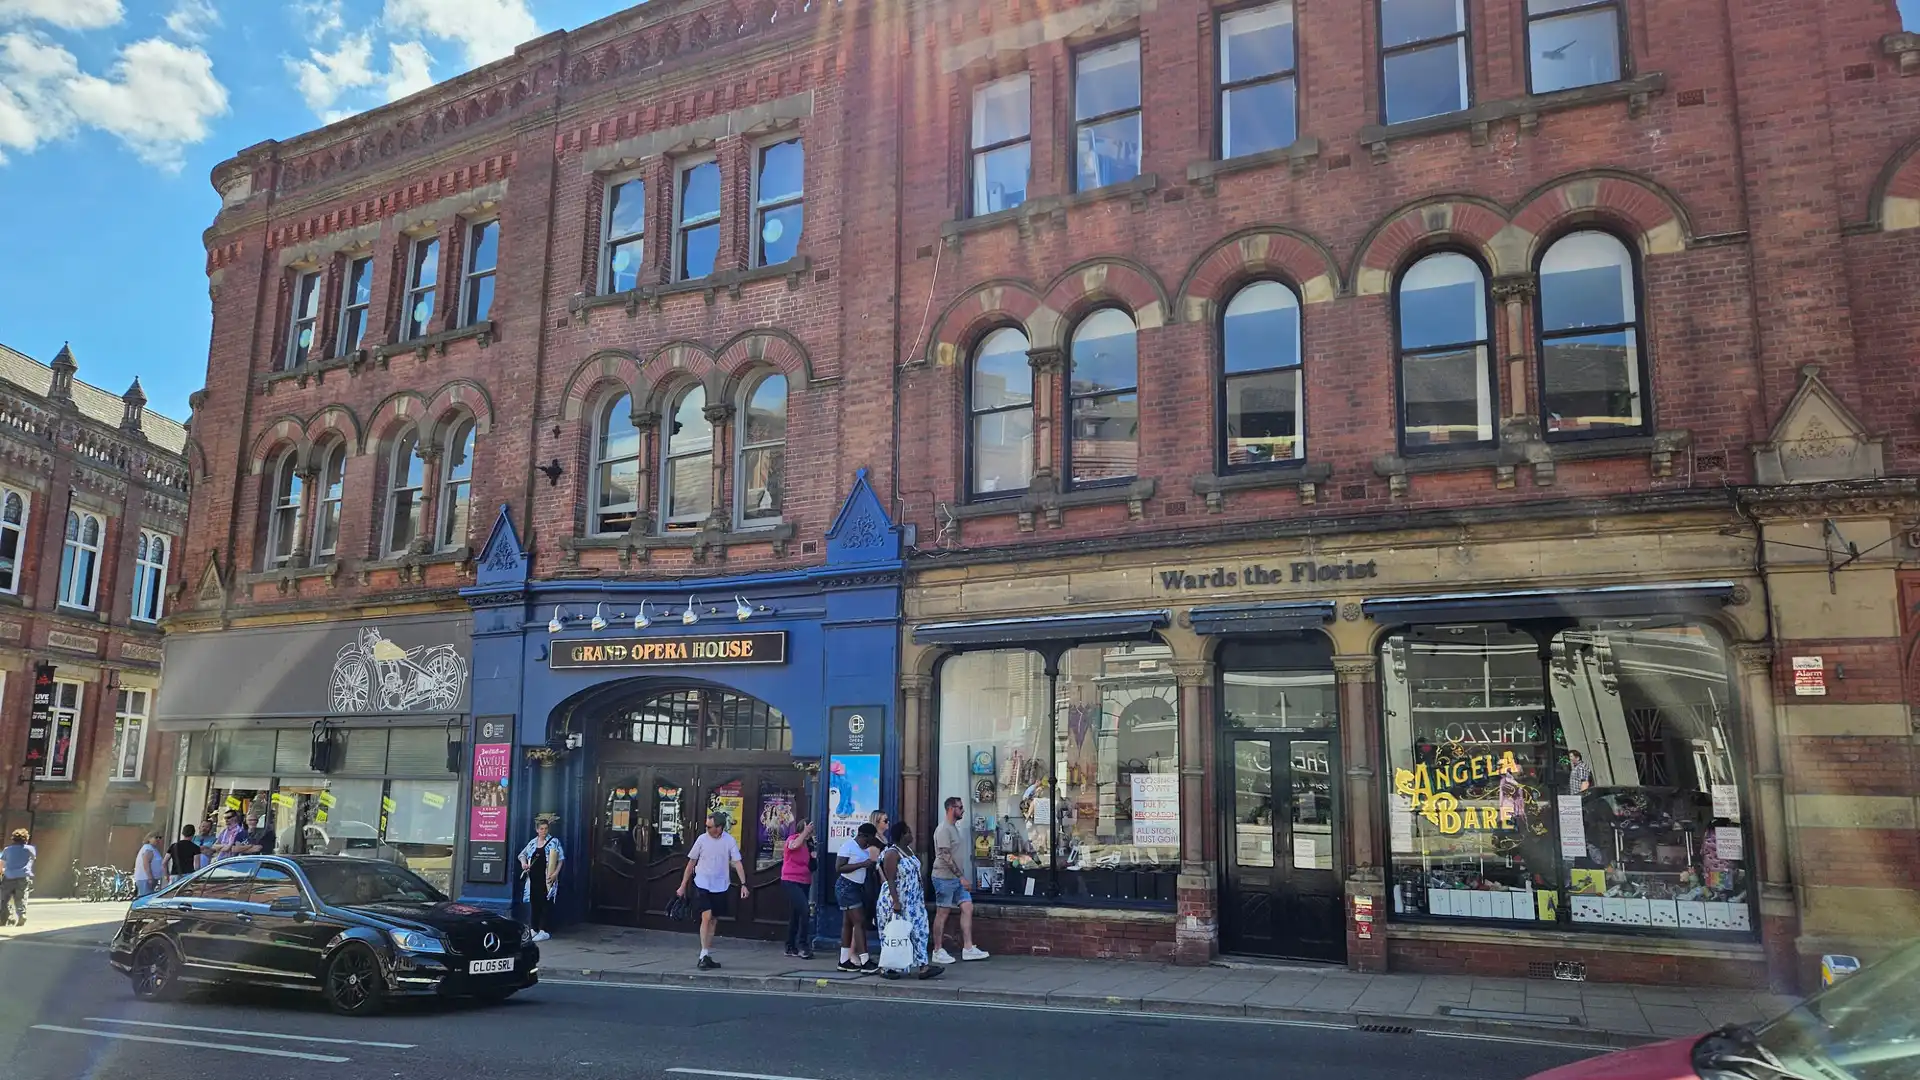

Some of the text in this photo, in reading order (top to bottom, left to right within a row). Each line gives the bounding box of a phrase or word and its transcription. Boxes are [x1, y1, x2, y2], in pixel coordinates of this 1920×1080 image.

[1159, 559, 1378, 590] Wards the Florist
[571, 640, 753, 661] GRAND OPERA HOUSE
[476, 755, 507, 767] AWFUL
[476, 766, 508, 776] AUNTIE
[1410, 751, 1519, 808] ANGELA
[709, 795, 721, 809] 39
[1436, 793, 1516, 834] BARE
[831, 826, 857, 838] hairs
[1152, 827, 1177, 835] STOCK
[1136, 835, 1155, 843] MUST
[882, 938, 909, 947] NEXT
[473, 960, 511, 972] CL05 SRL
